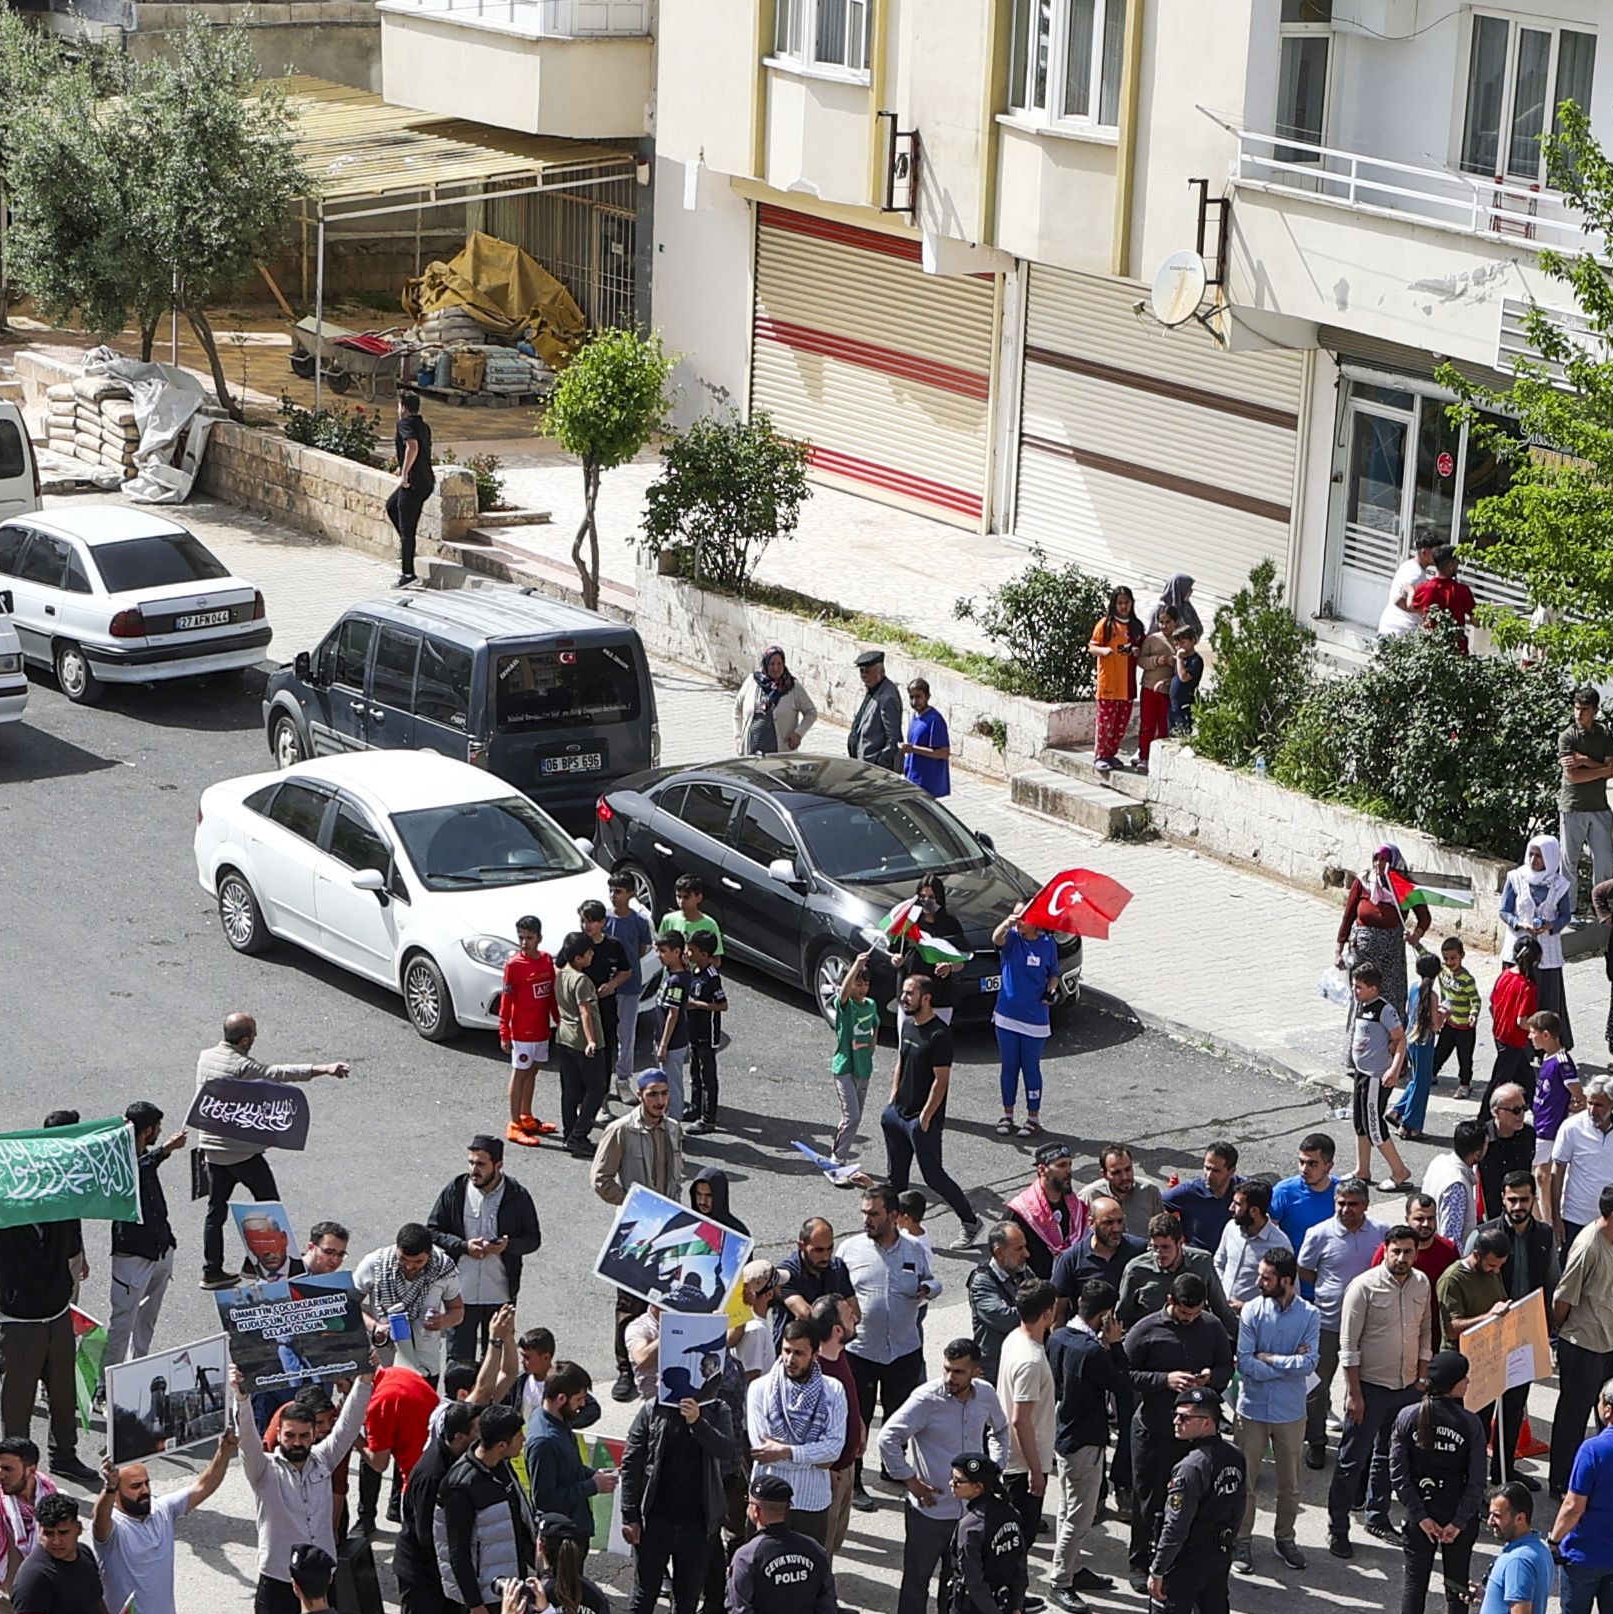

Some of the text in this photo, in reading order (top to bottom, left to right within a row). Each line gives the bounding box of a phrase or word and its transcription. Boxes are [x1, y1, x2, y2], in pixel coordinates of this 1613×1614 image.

[546, 754, 600, 771] 06 BPS 696
[986, 977, 1000, 990] 06
[231, 1294, 347, 1320] ÜMMETİN ÇOCUKLARINDAN
[262, 1326, 292, 1338] SELAM
